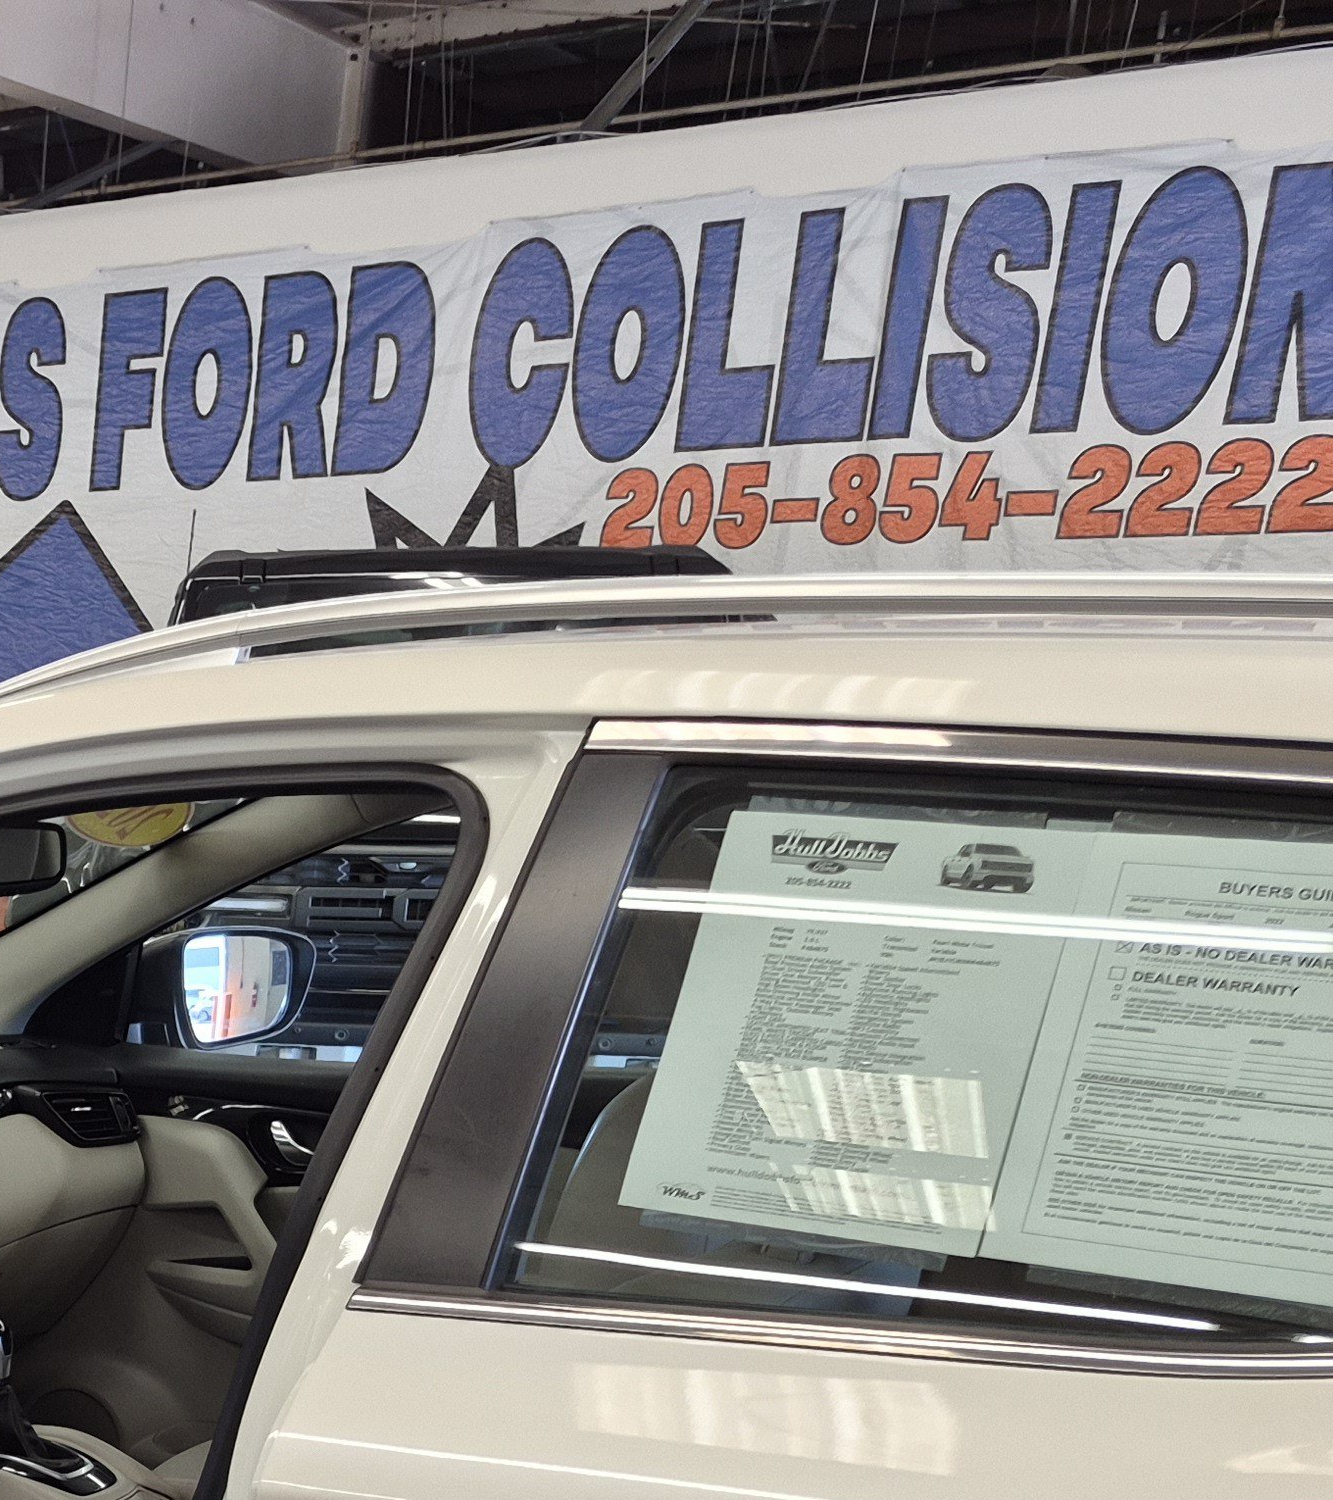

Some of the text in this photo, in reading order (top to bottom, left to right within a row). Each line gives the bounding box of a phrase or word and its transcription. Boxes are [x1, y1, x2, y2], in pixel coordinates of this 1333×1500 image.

[90, 260, 437, 492] FORD
[600, 435, 1333, 549] 205-854-2222
[774, 828, 892, 862] Hull Dobbs
[1218, 881, 1333, 901] BUYERS GUI
[1140, 942, 1166, 956] AS
[1166, 944, 1182, 956] IS
[1195, 945, 1221, 959] NO
[1224, 949, 1292, 967] DEALER
[1132, 970, 1300, 997] DEALER WARRANTY
